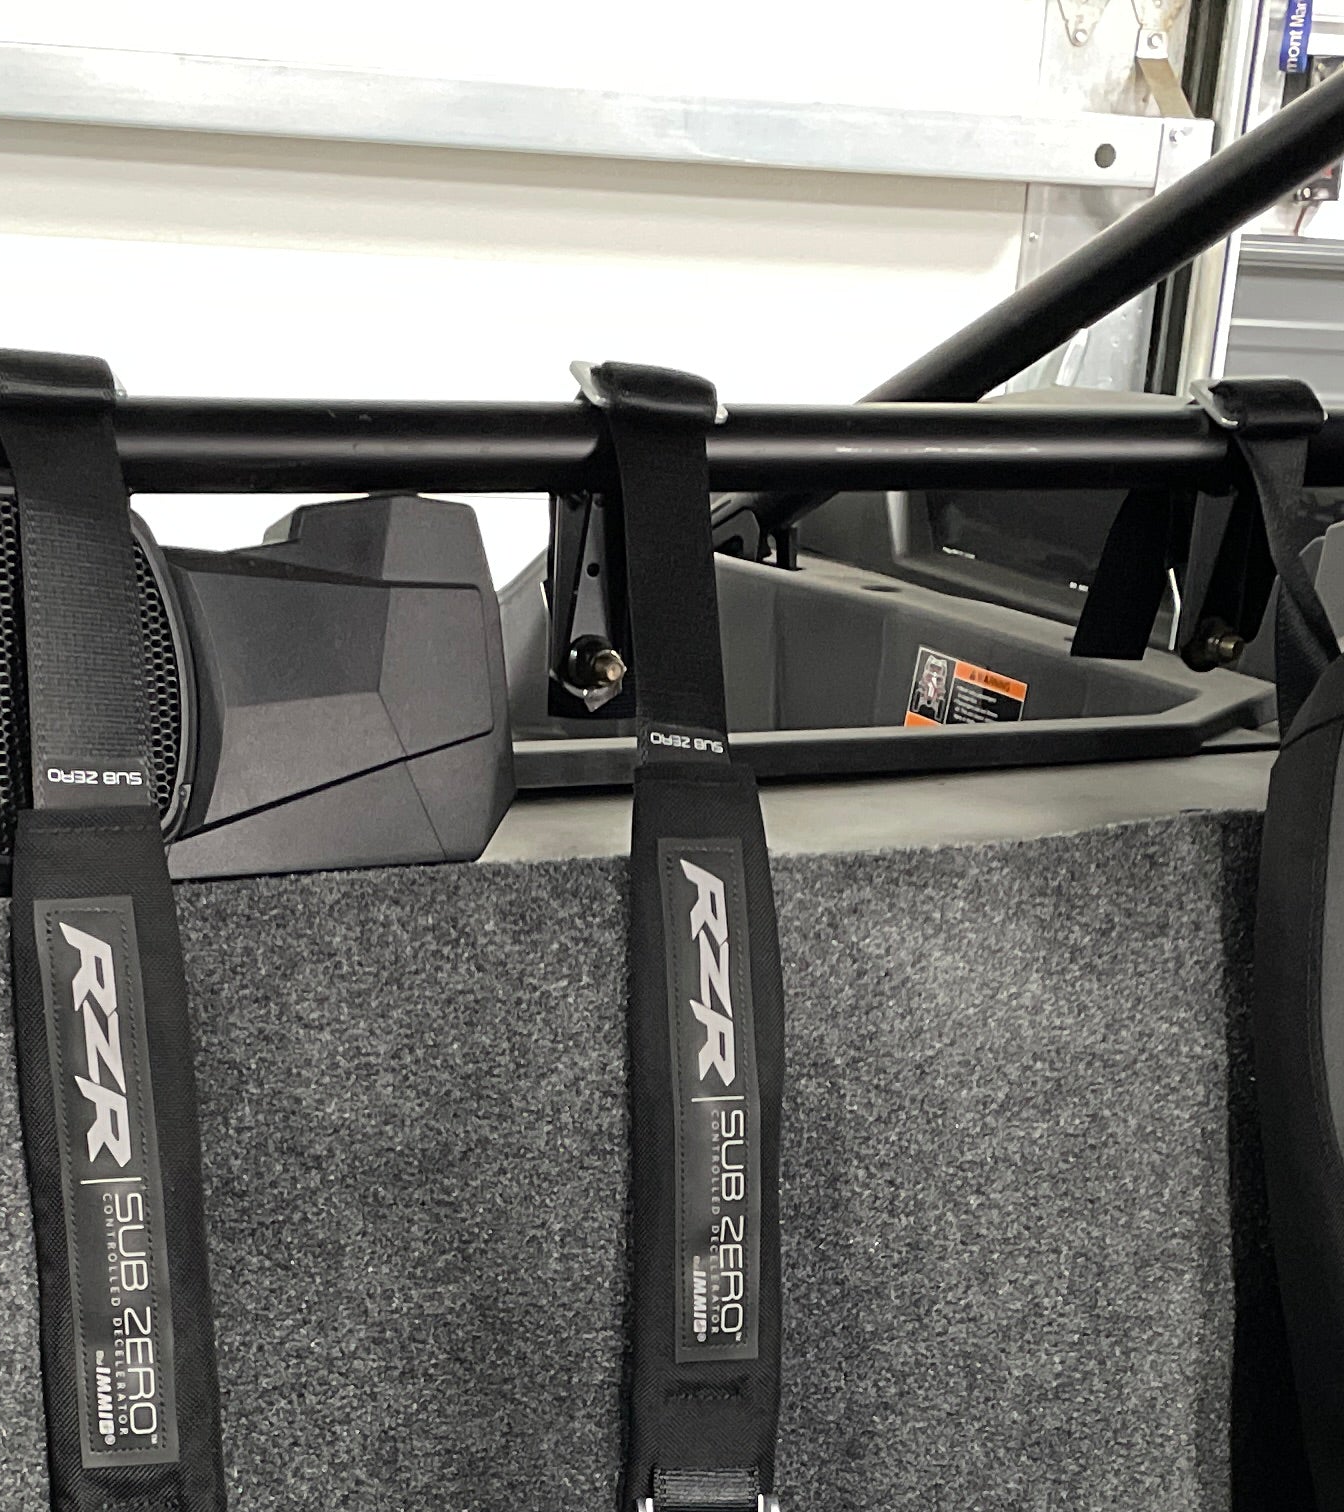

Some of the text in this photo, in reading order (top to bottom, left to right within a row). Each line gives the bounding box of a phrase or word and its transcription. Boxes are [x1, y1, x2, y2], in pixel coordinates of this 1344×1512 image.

[47, 768, 143, 786] SUB ZERO
[650, 732, 724, 754] SUB ZERO
[680, 858, 736, 1087] RZR
[59, 922, 131, 1168] RZR
[710, 1110, 721, 1216] CONTROLLED
[720, 1109, 746, 1202] SUB
[114, 1192, 150, 1292] SUB
[101, 1192, 129, 1436] CONTROLLED DECELERATOR
